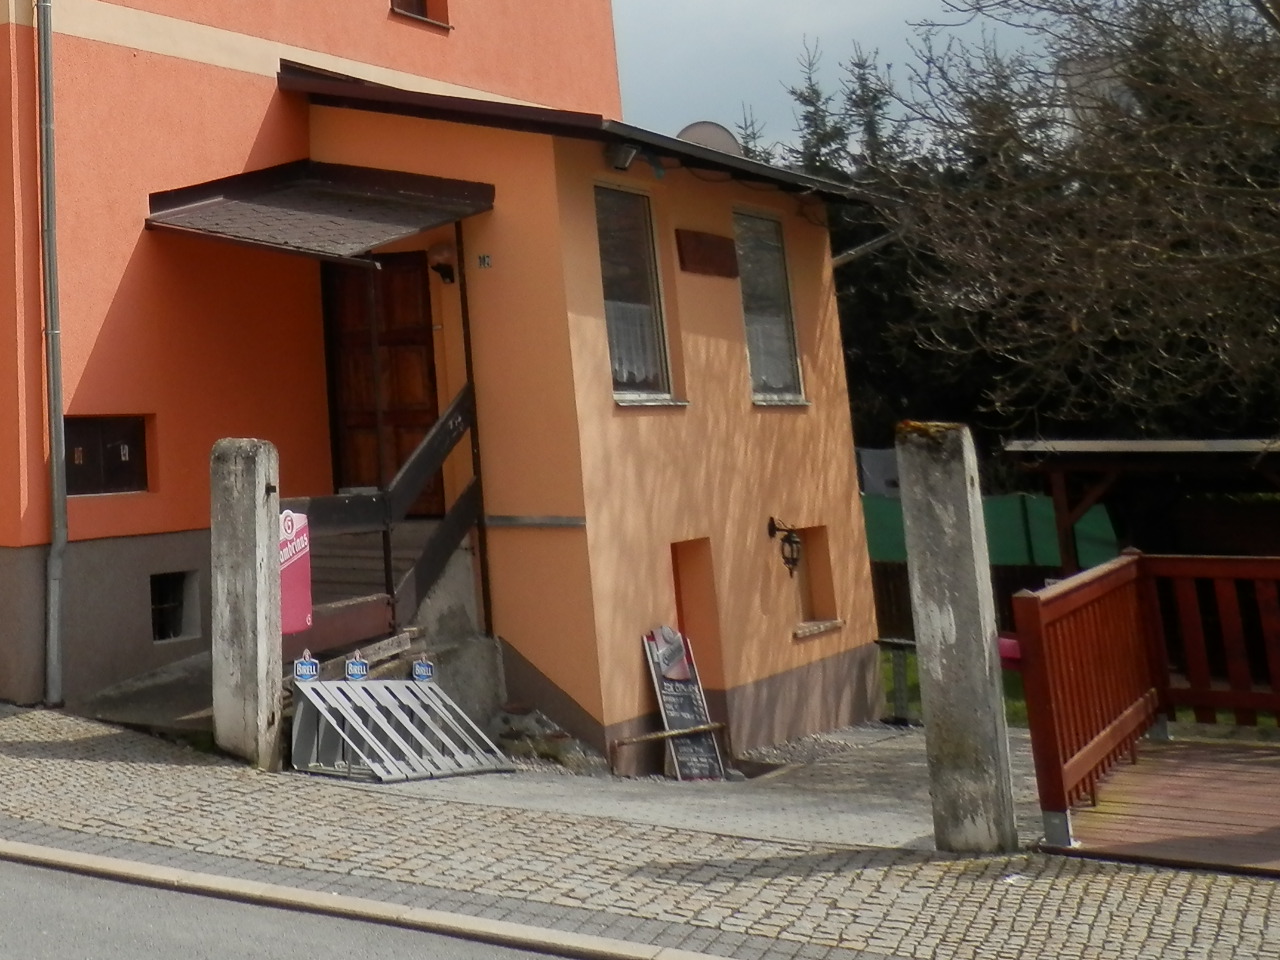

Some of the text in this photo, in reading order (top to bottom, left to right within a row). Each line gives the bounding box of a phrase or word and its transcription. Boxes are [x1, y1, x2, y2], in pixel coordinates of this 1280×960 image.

[280, 533, 309, 564] ambrinus
[296, 663, 317, 676] BIRELL
[348, 663, 367, 676] BIRELL
[414, 665, 432, 677] BIRELL
